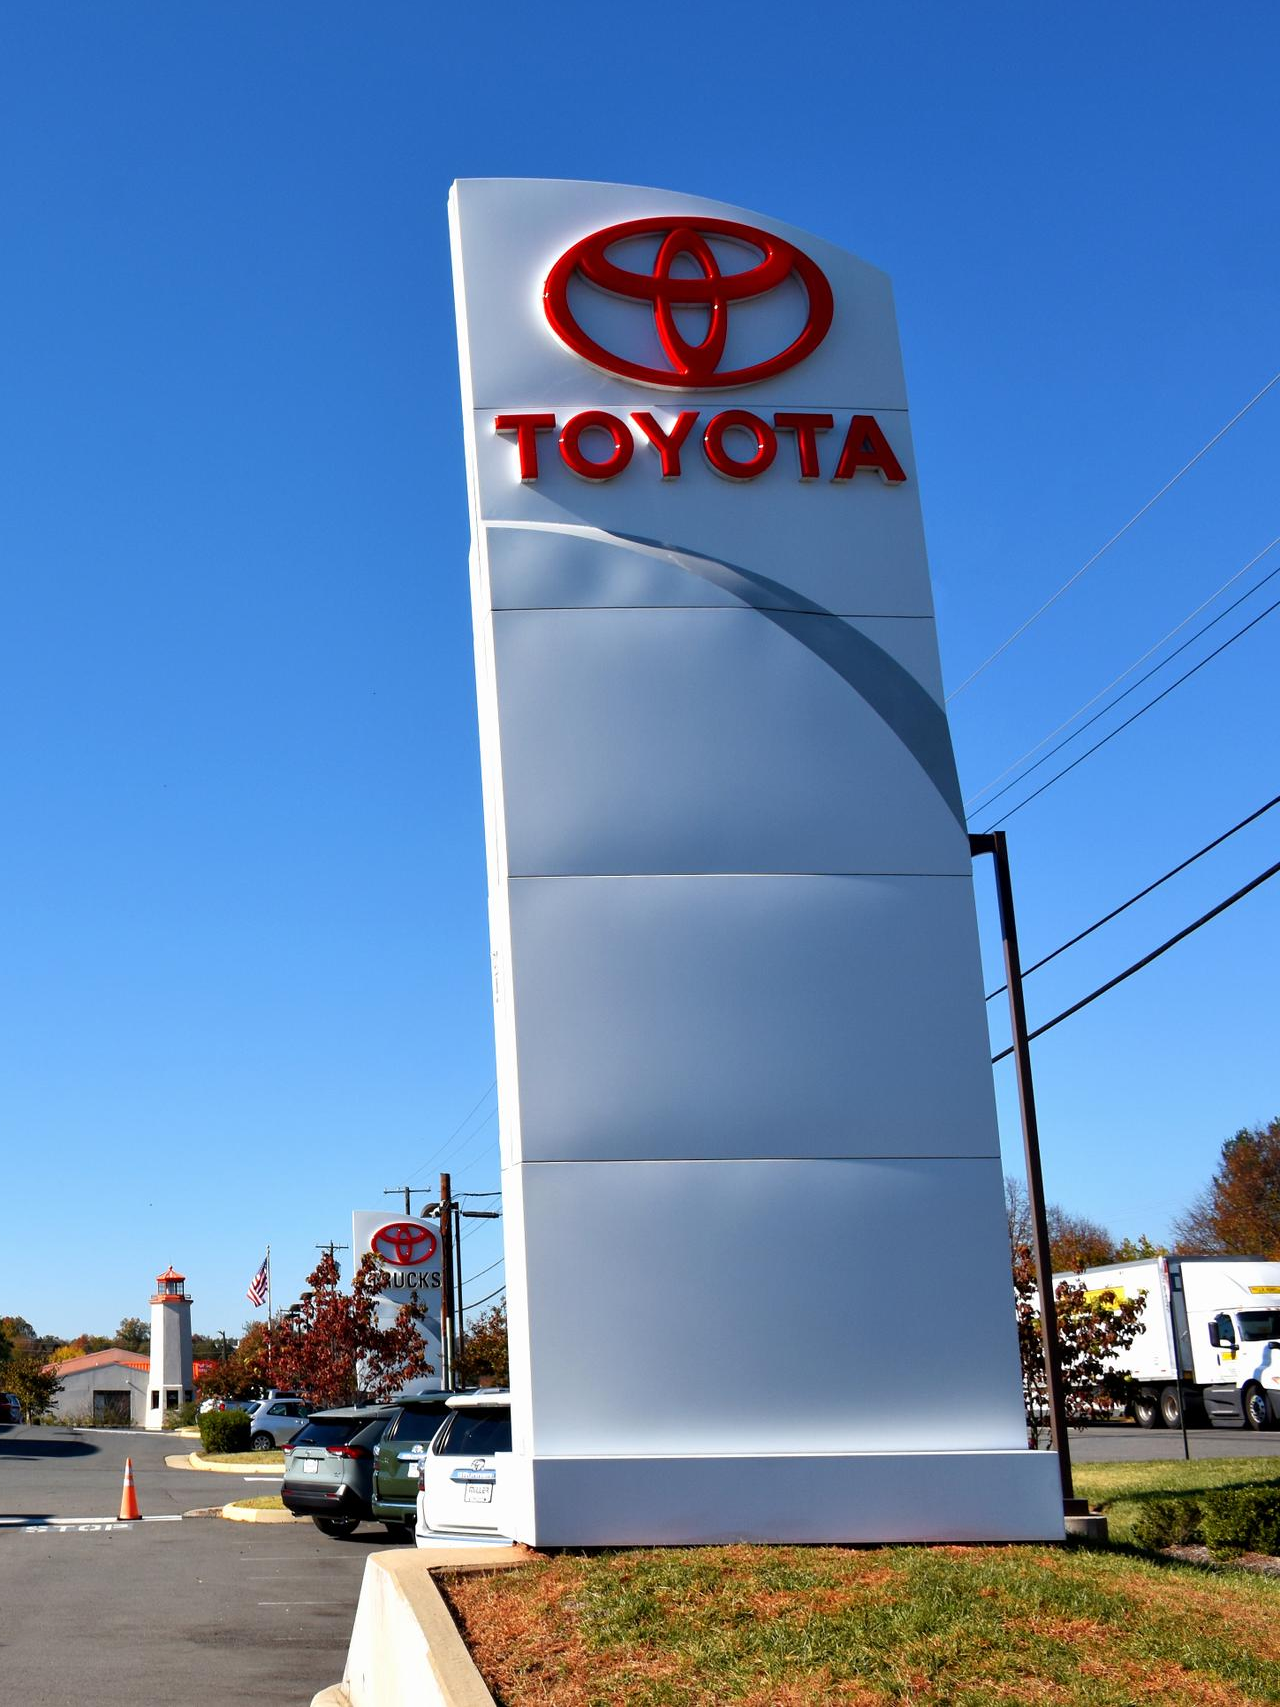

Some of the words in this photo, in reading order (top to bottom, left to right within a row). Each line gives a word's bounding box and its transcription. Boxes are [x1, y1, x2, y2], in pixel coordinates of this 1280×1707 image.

[494, 410, 907, 485] TOYOTA
[365, 1271, 441, 1289] RUCKS
[25, 1523, 129, 1534] STOP
